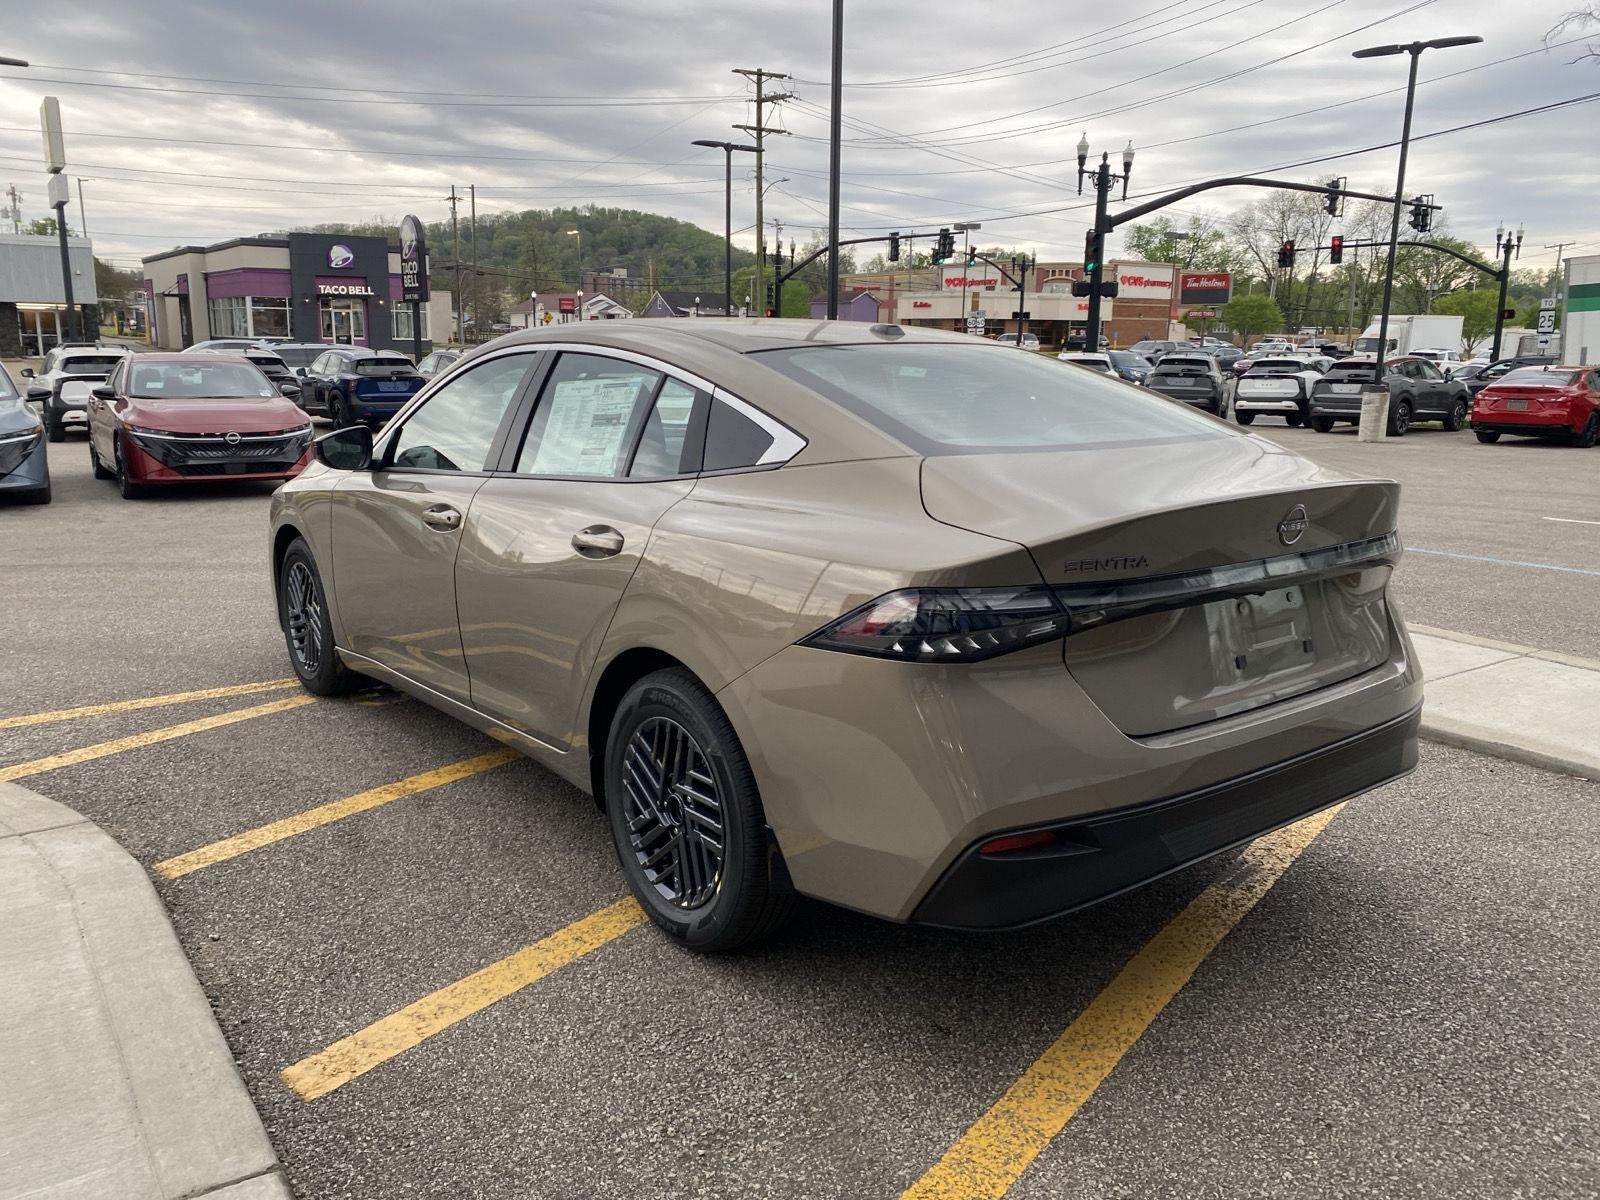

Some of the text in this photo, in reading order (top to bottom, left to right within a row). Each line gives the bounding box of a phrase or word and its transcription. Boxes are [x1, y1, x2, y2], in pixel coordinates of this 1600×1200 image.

[402, 262, 418, 274] TACO
[404, 275, 419, 287] BELL
[1128, 275, 1173, 289] CVS pharmacy
[1186, 277, 1226, 288] Tim Hortons
[318, 285, 375, 295] TACO BELL
[1539, 315, 1554, 328] 25
[1064, 555, 1150, 573] SENTRA
